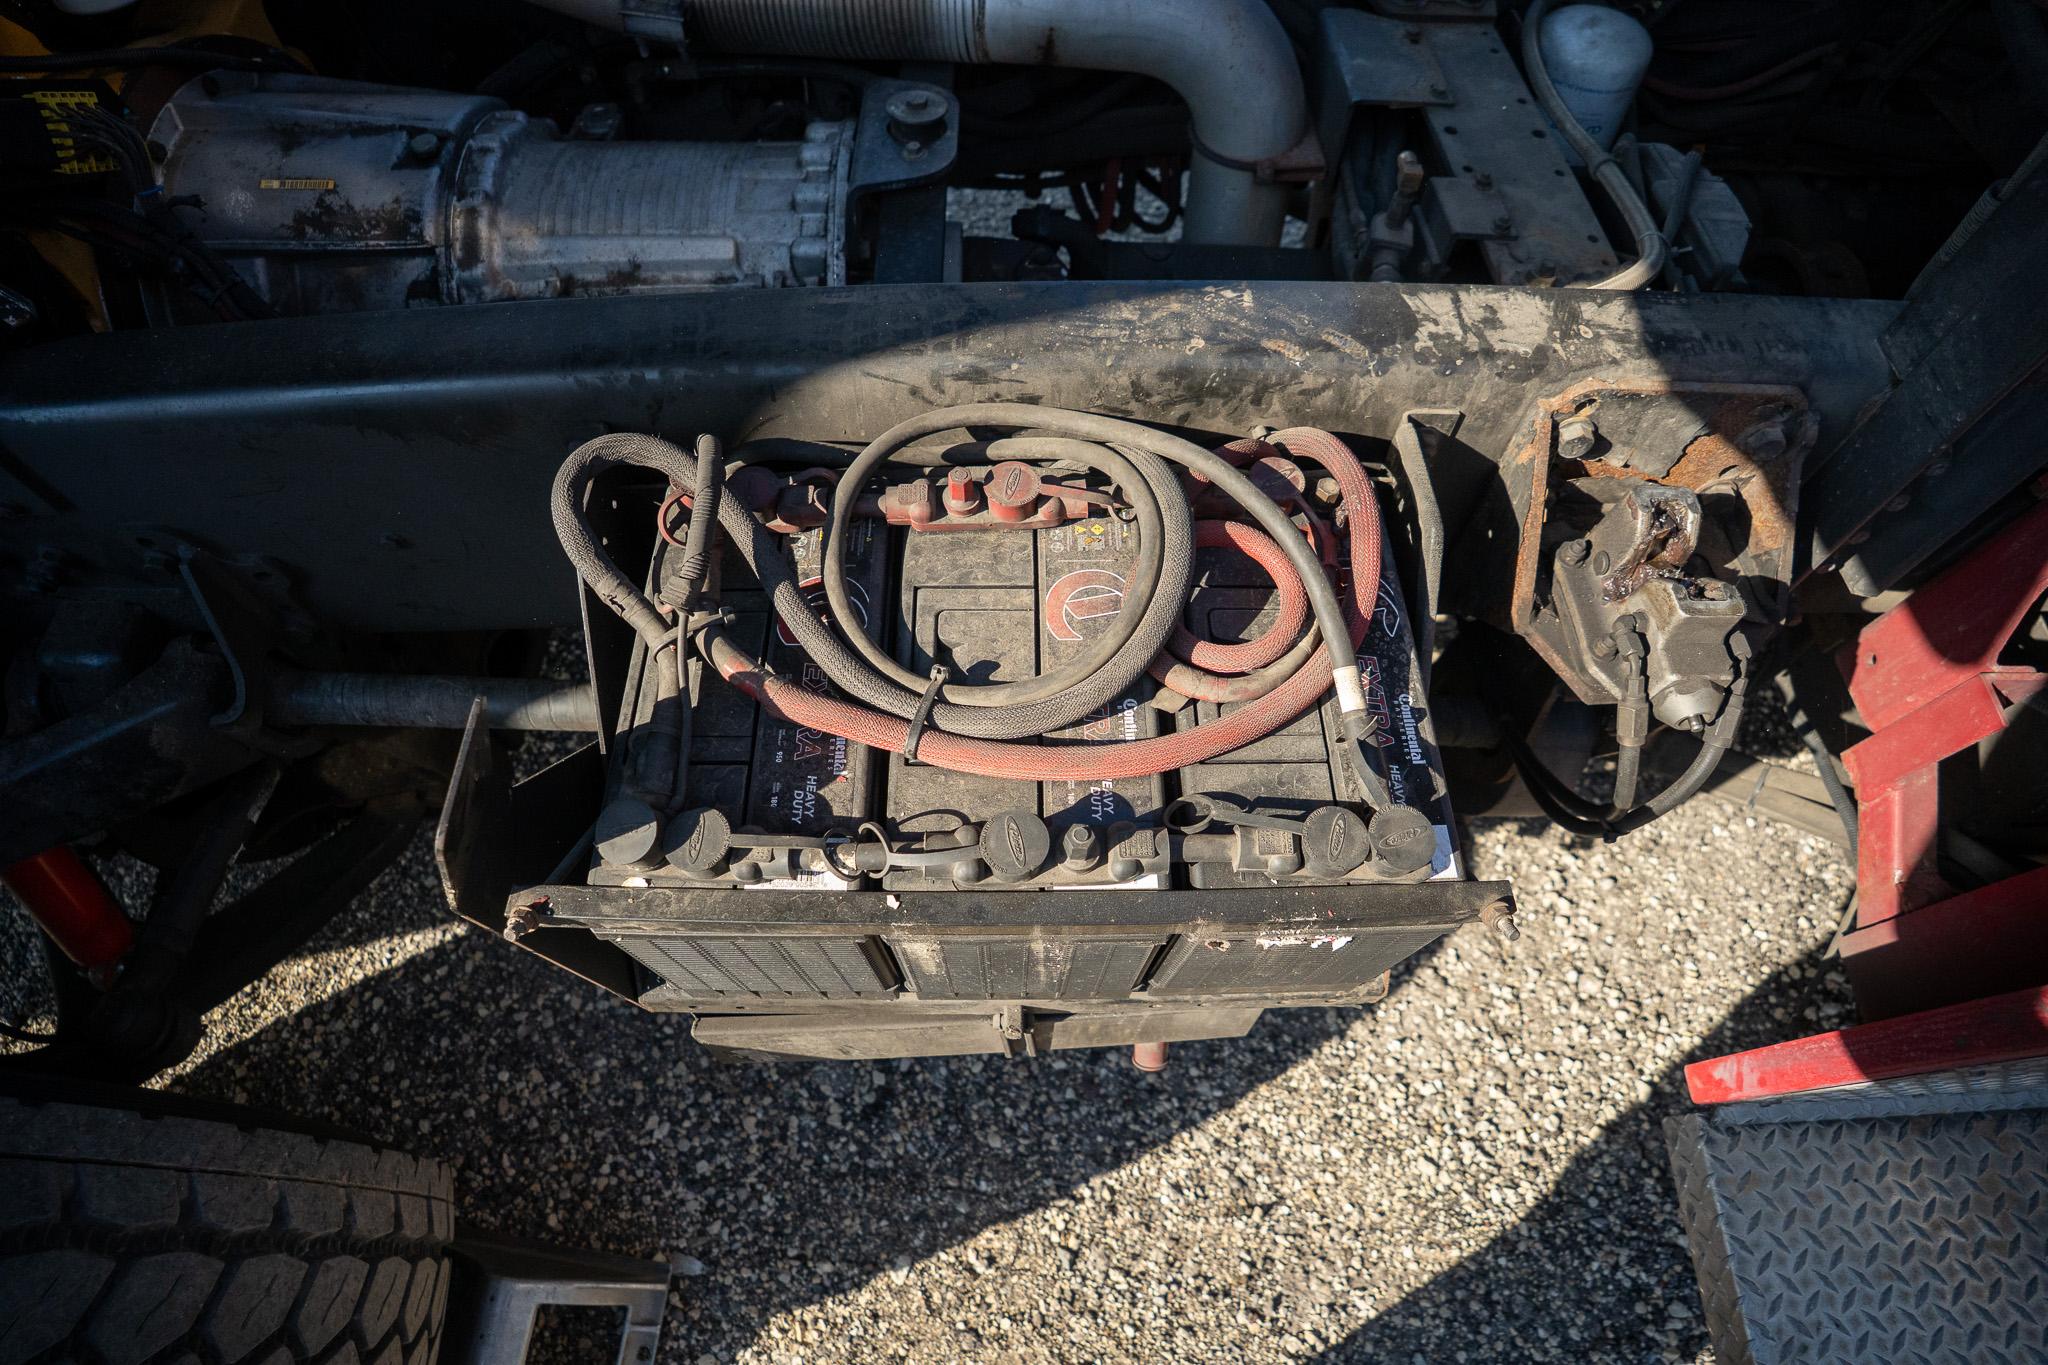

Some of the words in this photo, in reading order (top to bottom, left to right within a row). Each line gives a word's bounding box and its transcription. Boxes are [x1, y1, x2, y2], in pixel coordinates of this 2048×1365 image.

[793, 662, 829, 761] EXRA
[1122, 698, 1138, 741] Contin
[1356, 654, 1395, 749] EXTRA
[1393, 700, 1411, 760] BATTERIES
[1398, 693, 1427, 766] Continental
[774, 751, 783, 763] 950
[833, 737, 847, 776] nental
[804, 775, 818, 818] HEAVY
[1090, 786, 1103, 821] DUTY
[1101, 778, 1114, 815] EAVY
[1388, 764, 1406, 807] HEAVY
[791, 790, 804, 825] DUTY
